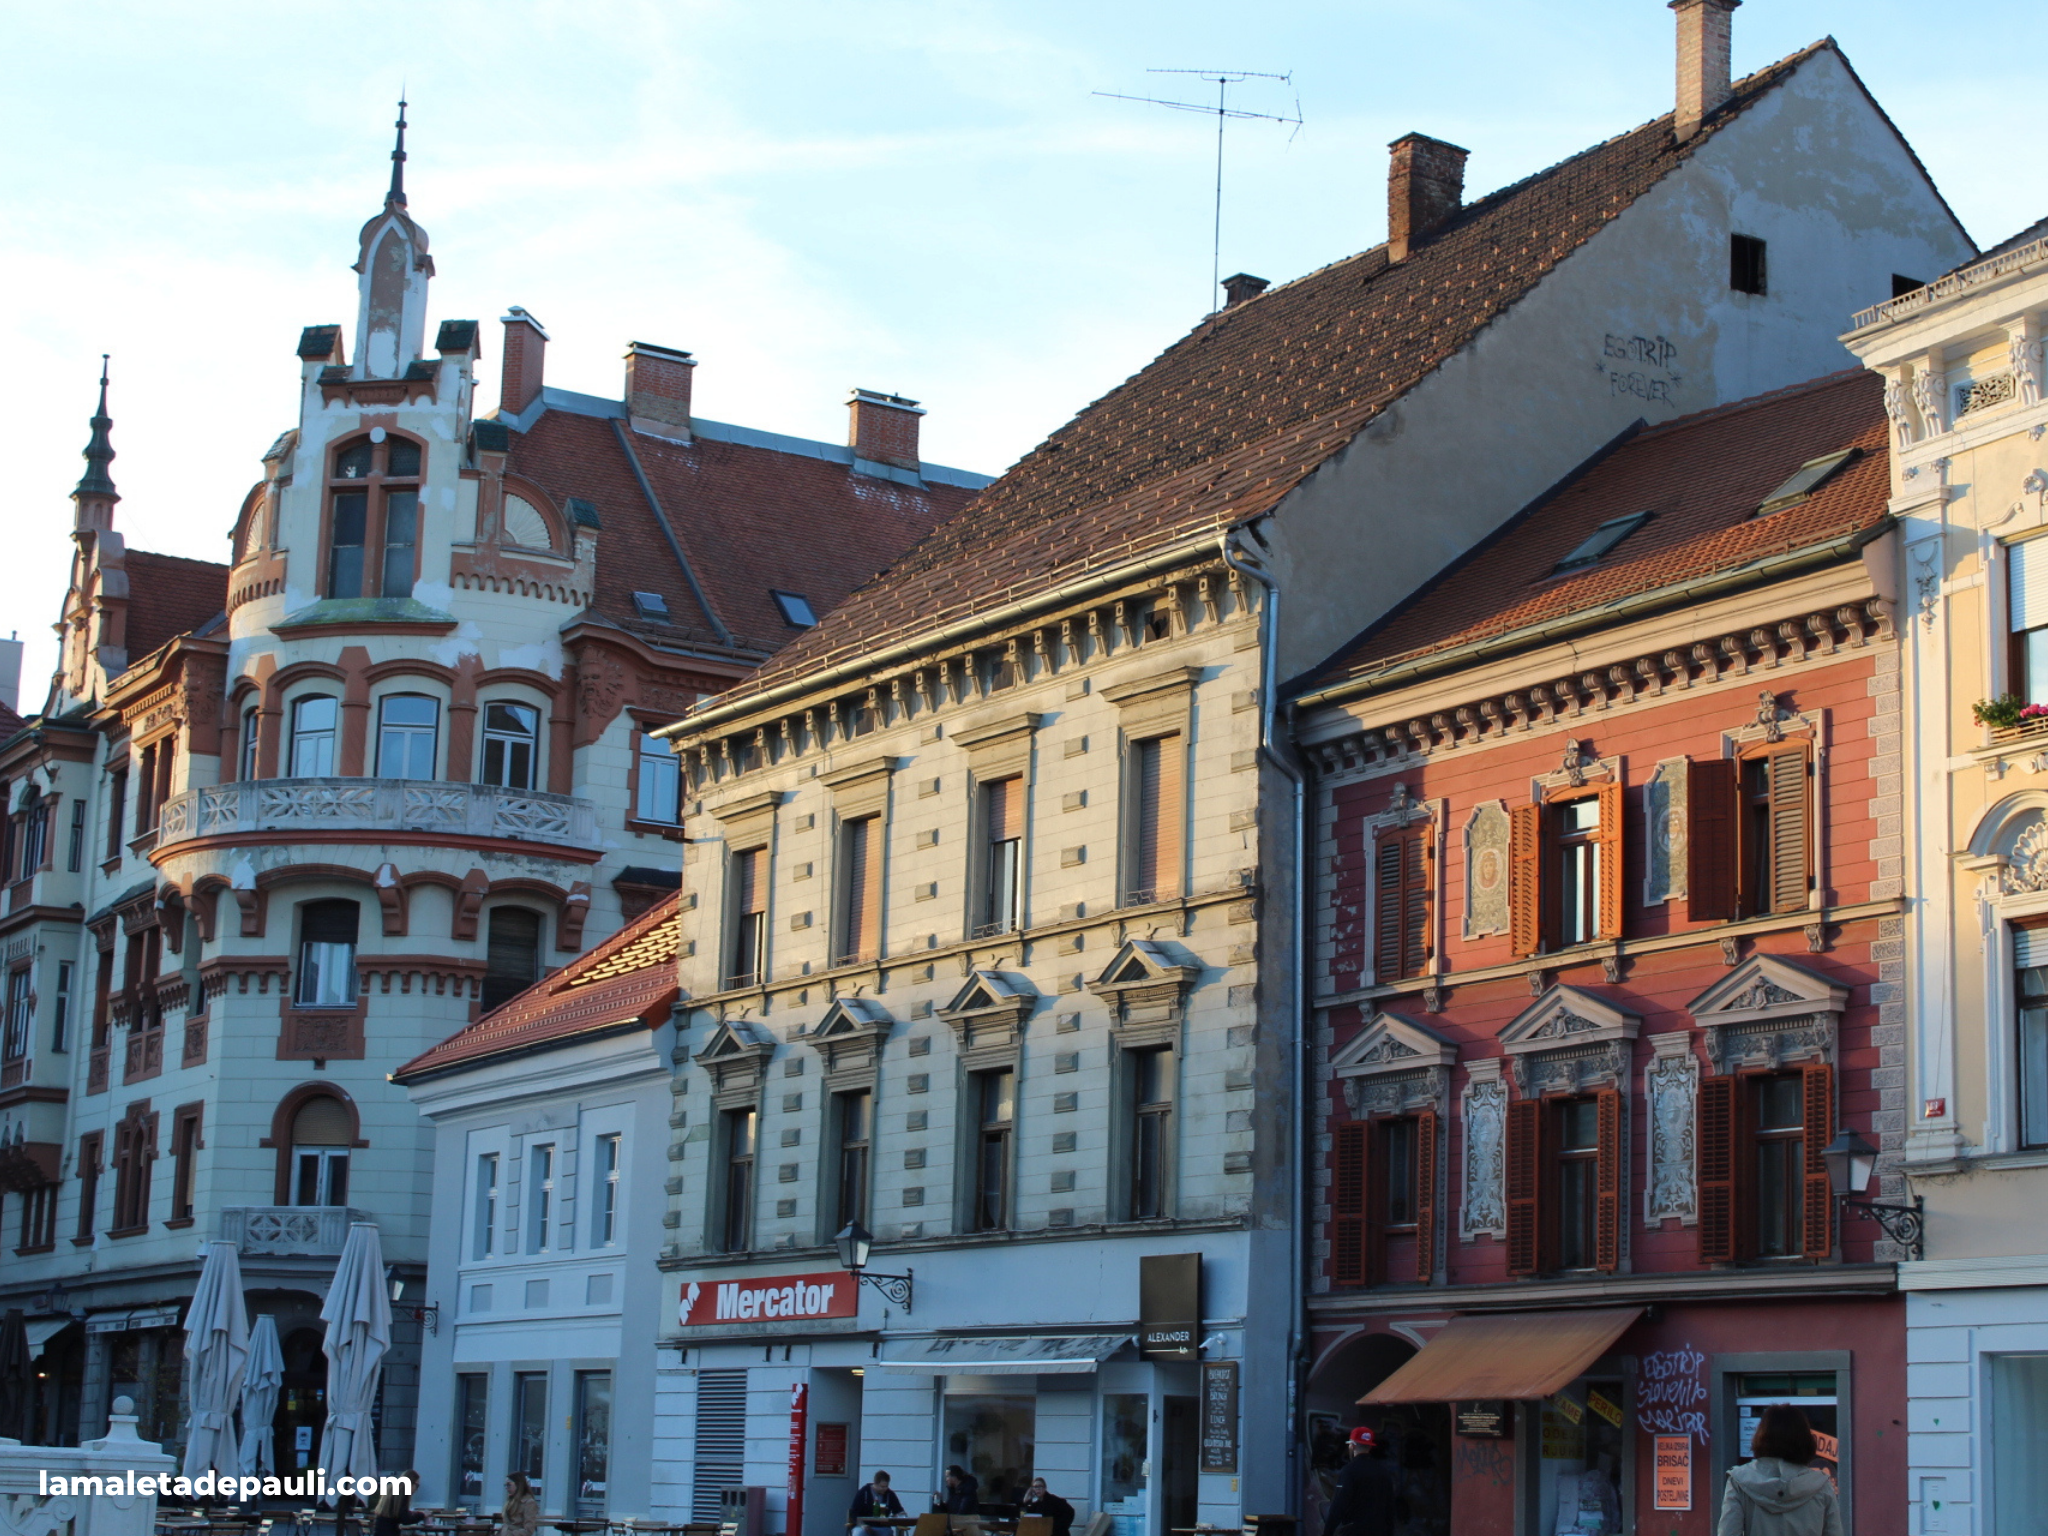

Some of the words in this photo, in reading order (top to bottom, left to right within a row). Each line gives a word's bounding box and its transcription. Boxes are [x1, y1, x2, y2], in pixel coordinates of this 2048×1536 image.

[1610, 371, 1675, 408] FOREVER
[716, 1280, 835, 1320] Mercator
[1147, 1331, 1190, 1342] ALEXANDER
[1589, 1391, 1623, 1424] PERILO
[1657, 1453, 1689, 1467] BRISAČ
[1662, 1477, 1683, 1485] DNEVI
